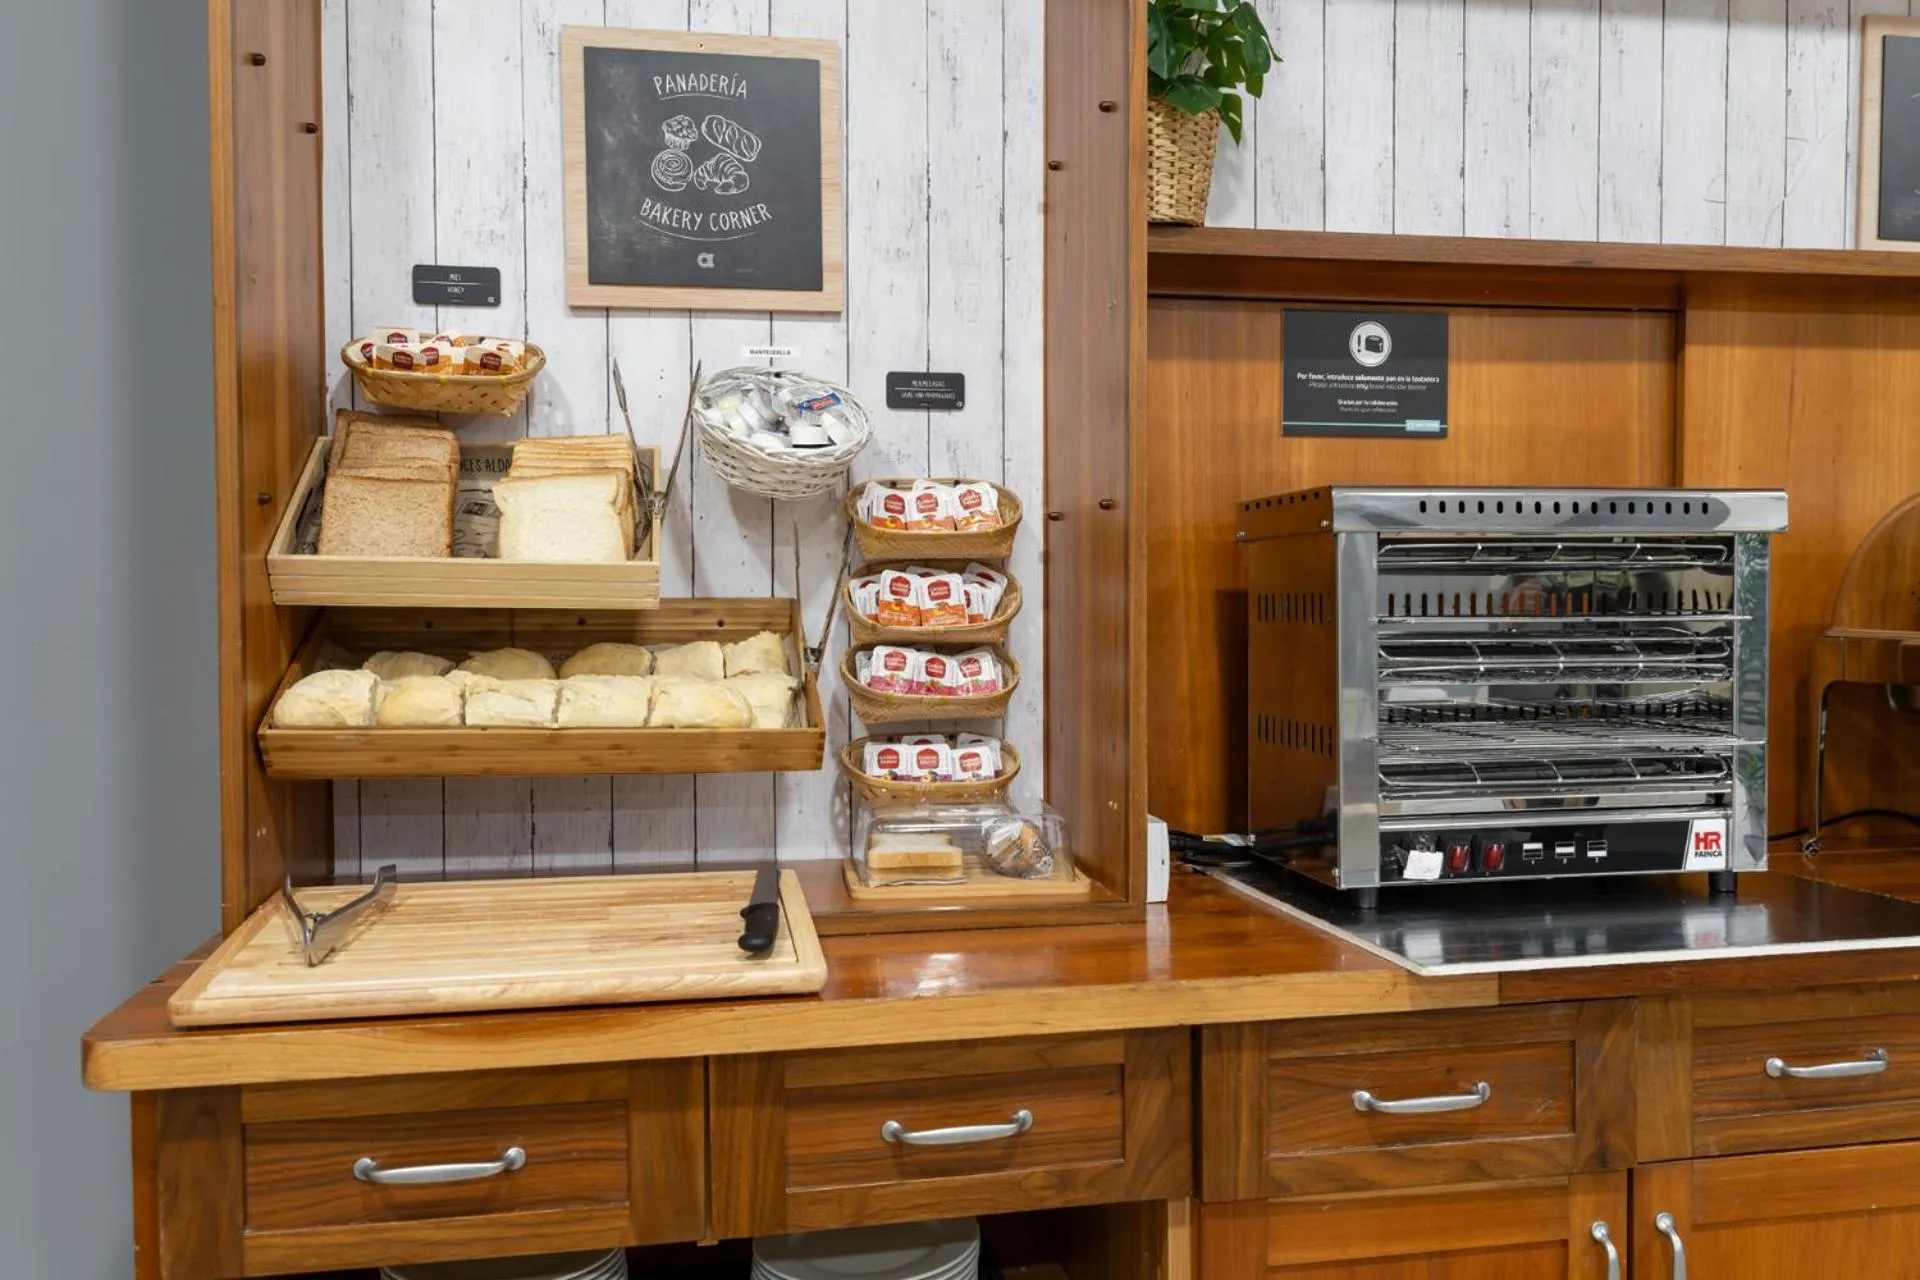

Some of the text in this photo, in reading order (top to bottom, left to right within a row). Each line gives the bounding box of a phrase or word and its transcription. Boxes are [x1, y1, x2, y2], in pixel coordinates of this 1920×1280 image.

[653, 72, 748, 99] PANADERÍA
[640, 198, 772, 231] BAKERY CORNER
[1297, 372, 1308, 380] Por
[460, 459, 481, 472] CES
[1694, 831, 1722, 850] HR
